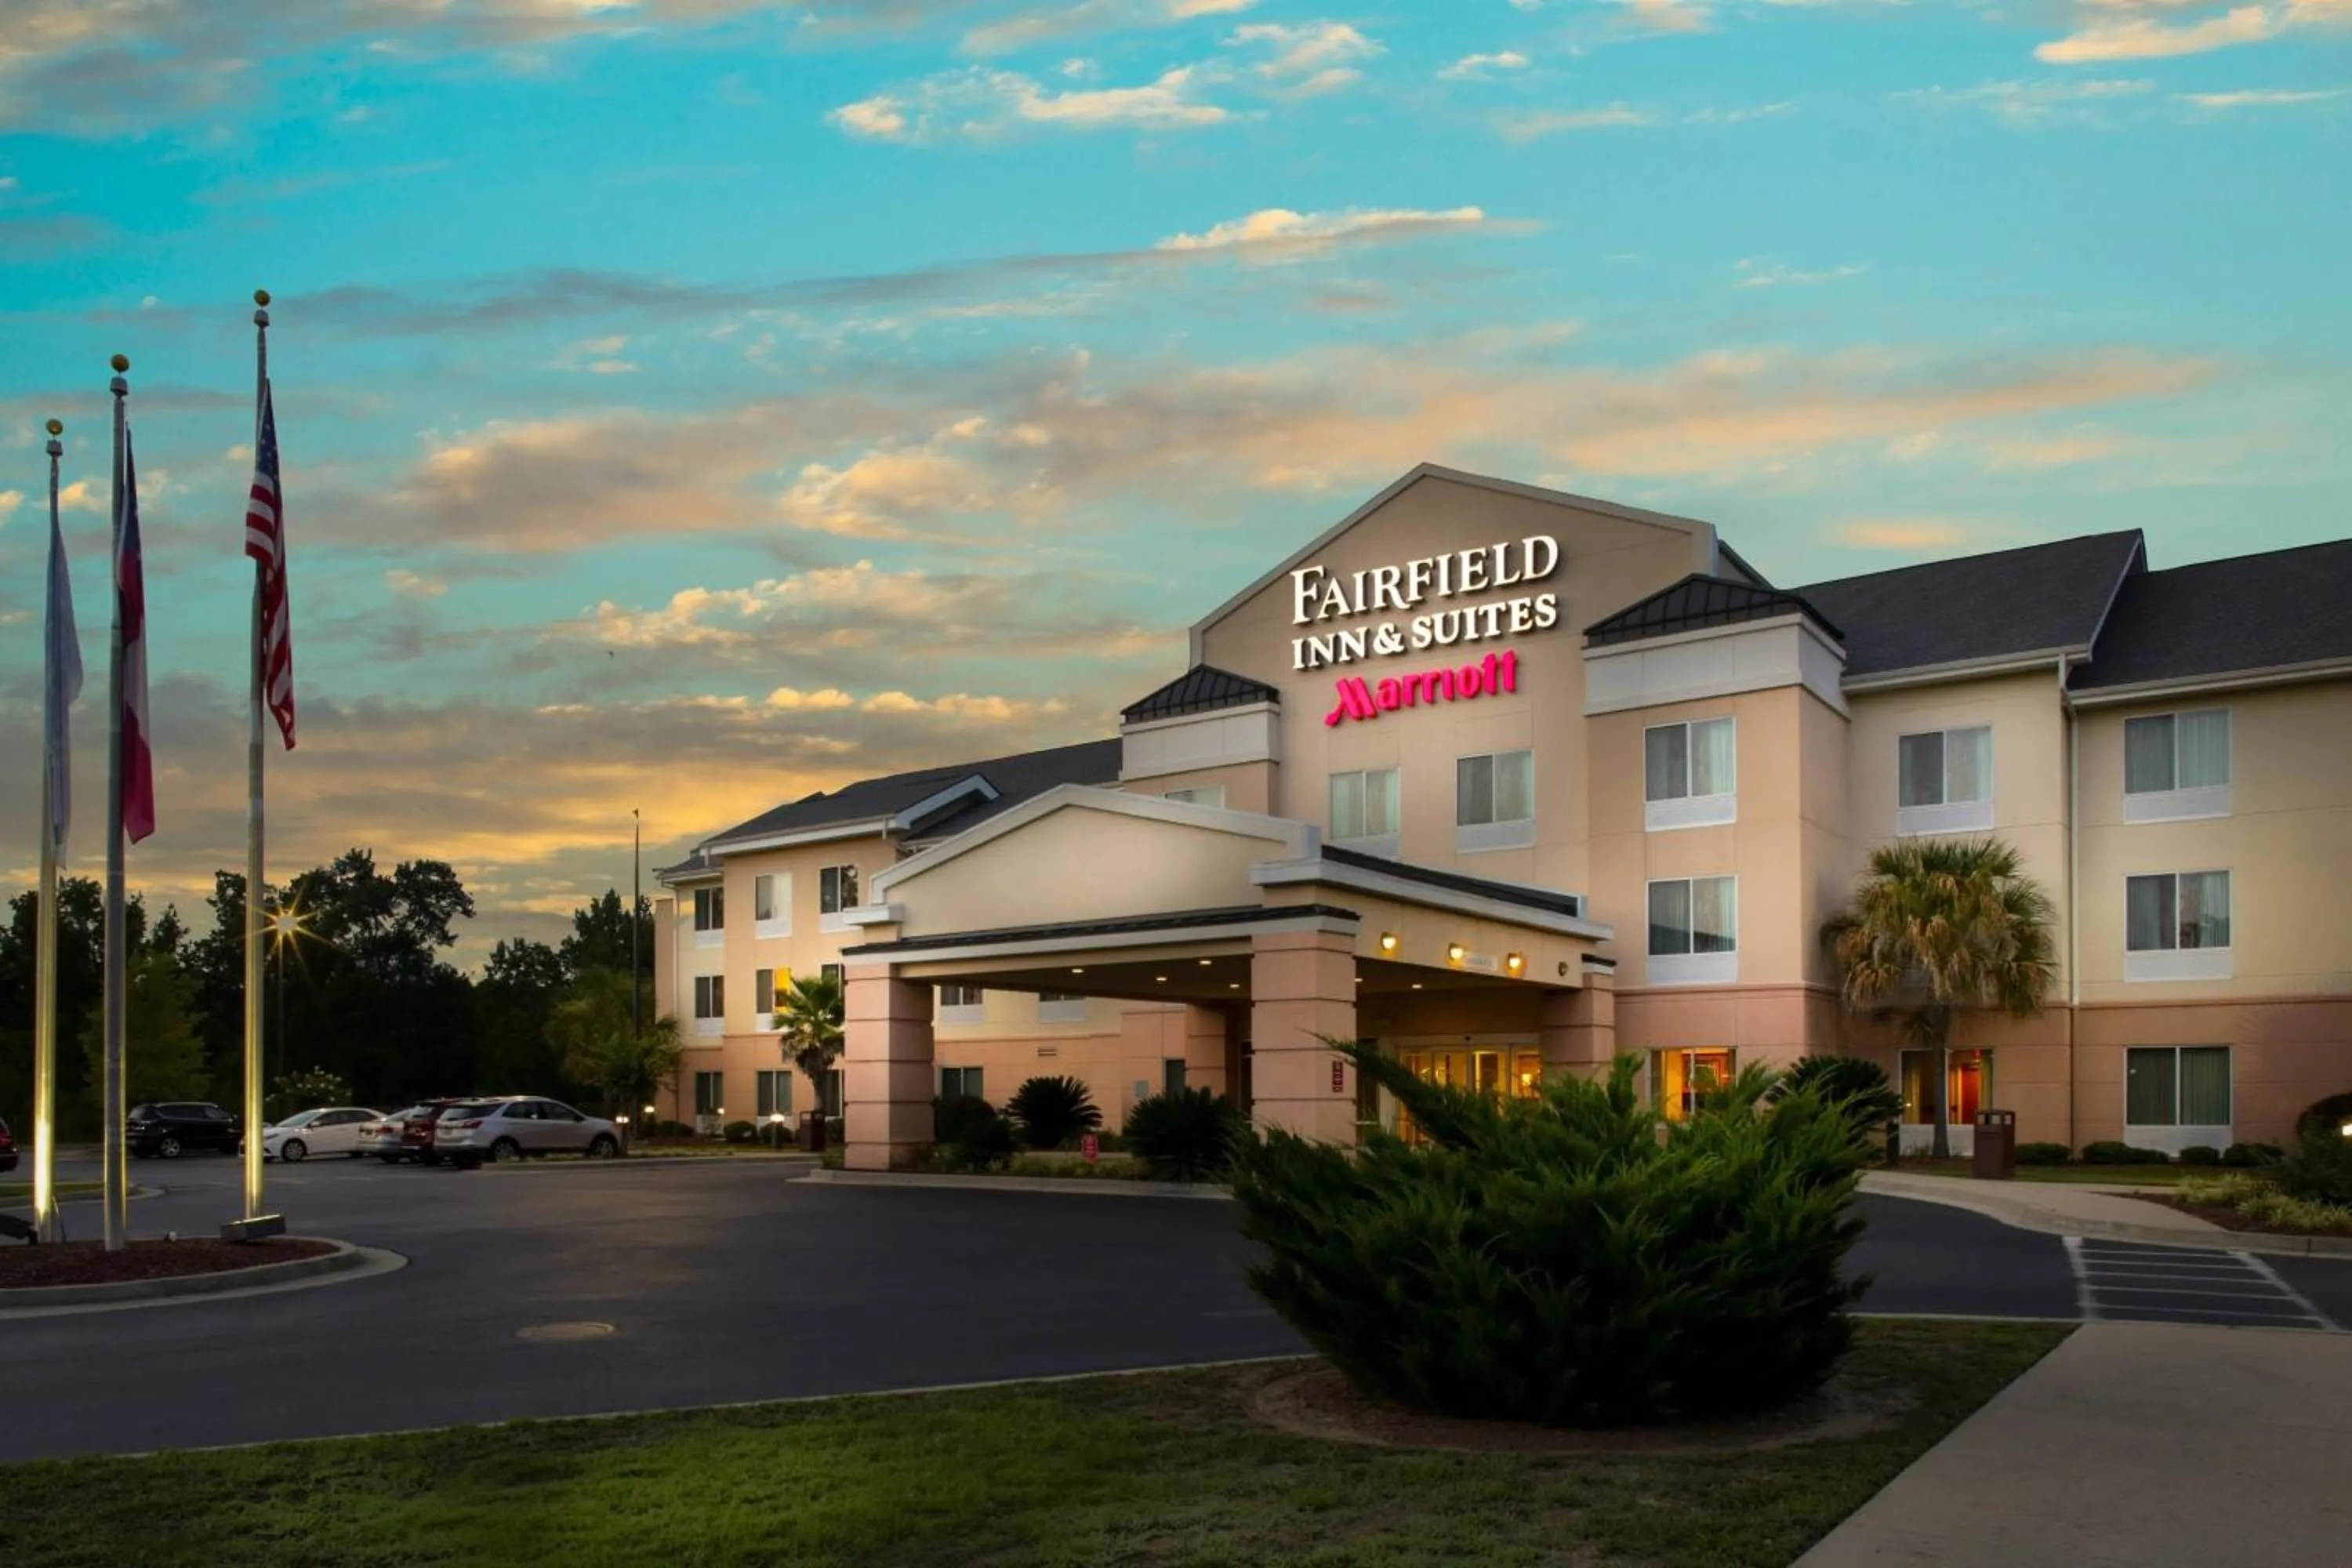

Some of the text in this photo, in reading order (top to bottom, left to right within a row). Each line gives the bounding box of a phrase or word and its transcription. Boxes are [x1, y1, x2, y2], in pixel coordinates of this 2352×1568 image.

[1290, 535, 1559, 626] FAIRFIELD
[1411, 593, 1558, 649] SUITES
[1324, 649, 1518, 728] Marriott
